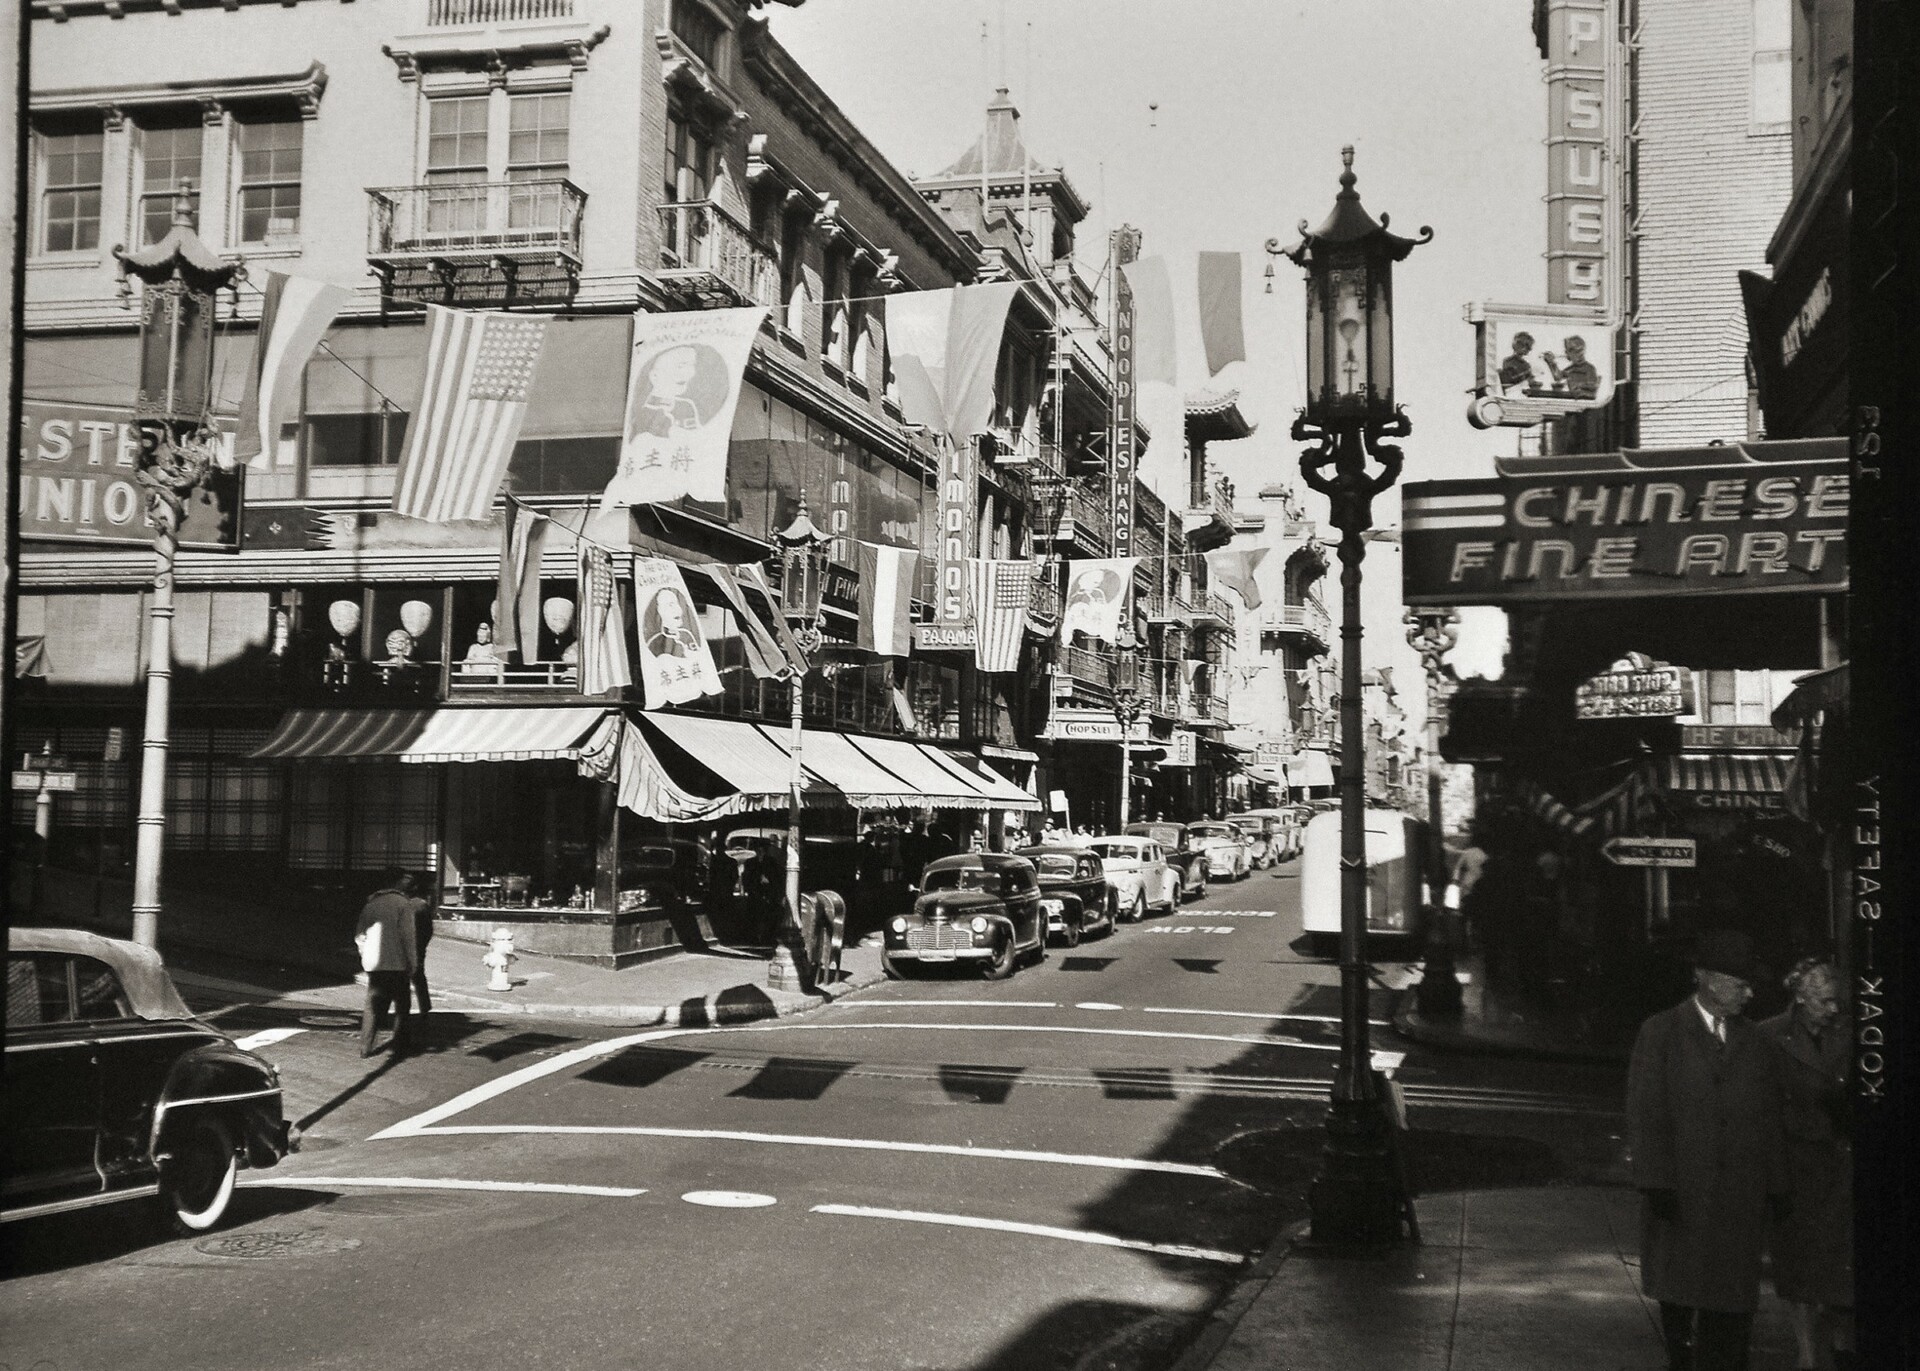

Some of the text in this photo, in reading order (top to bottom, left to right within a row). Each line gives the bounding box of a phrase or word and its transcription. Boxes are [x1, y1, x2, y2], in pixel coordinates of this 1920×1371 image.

[1117, 311, 1132, 469] NOODLES
[1116, 483, 1130, 541] HANG
[1512, 474, 1850, 529] CHINESE
[1449, 528, 1849, 584] FINE ART
[1065, 723, 1090, 735] CHOP
[1661, 847, 1692, 857] WAY
[1143, 926, 1236, 935] SLOW
